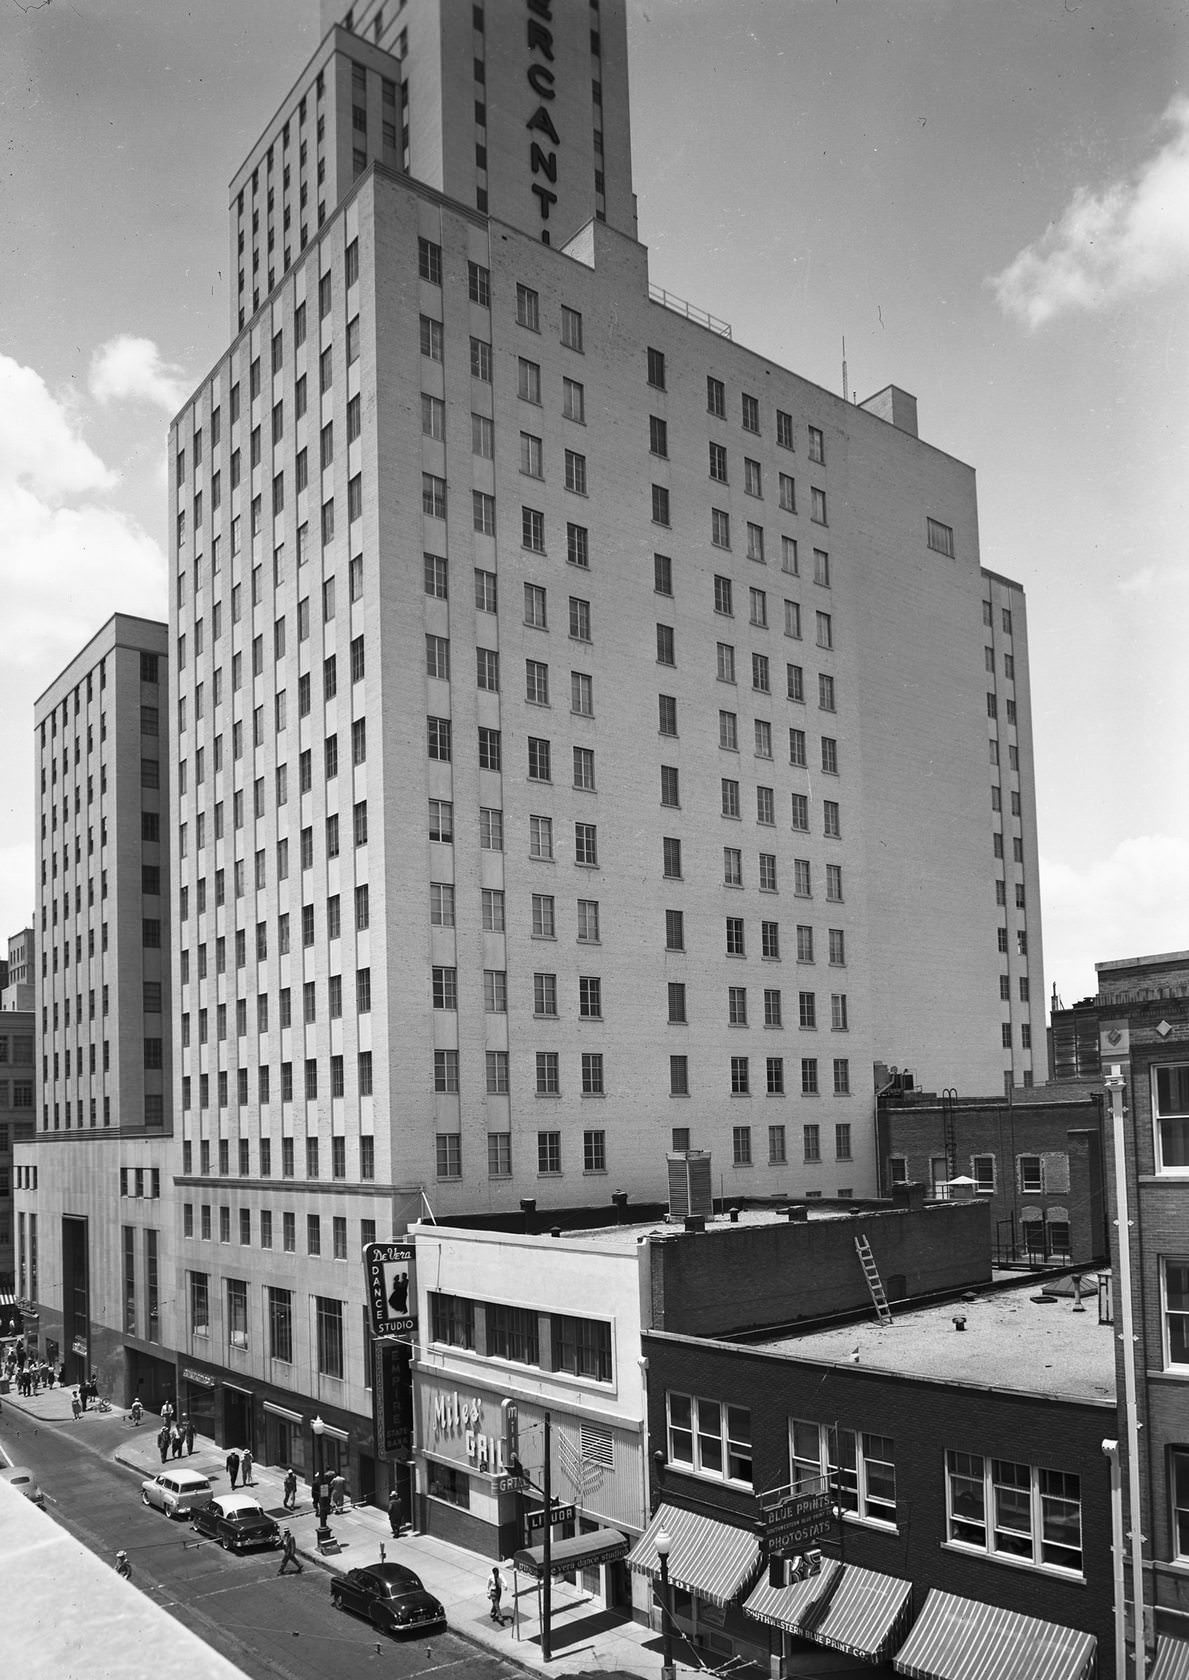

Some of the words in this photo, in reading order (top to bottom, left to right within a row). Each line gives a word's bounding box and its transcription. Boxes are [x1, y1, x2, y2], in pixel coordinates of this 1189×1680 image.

[373, 1248, 388, 1262] De
[387, 1247, 412, 1261] Vera
[371, 1265, 384, 1320] DANCE
[378, 1320, 414, 1333] STUDIO
[532, 1508, 573, 1527] LIUOR
[768, 1506, 793, 1524] BLUE
[796, 1495, 830, 1514] PRINTS
[768, 1520, 831, 1548] PHOTOSTATS
[805, 1630, 823, 1645] BLUE
[825, 1637, 852, 1654] PRINT
